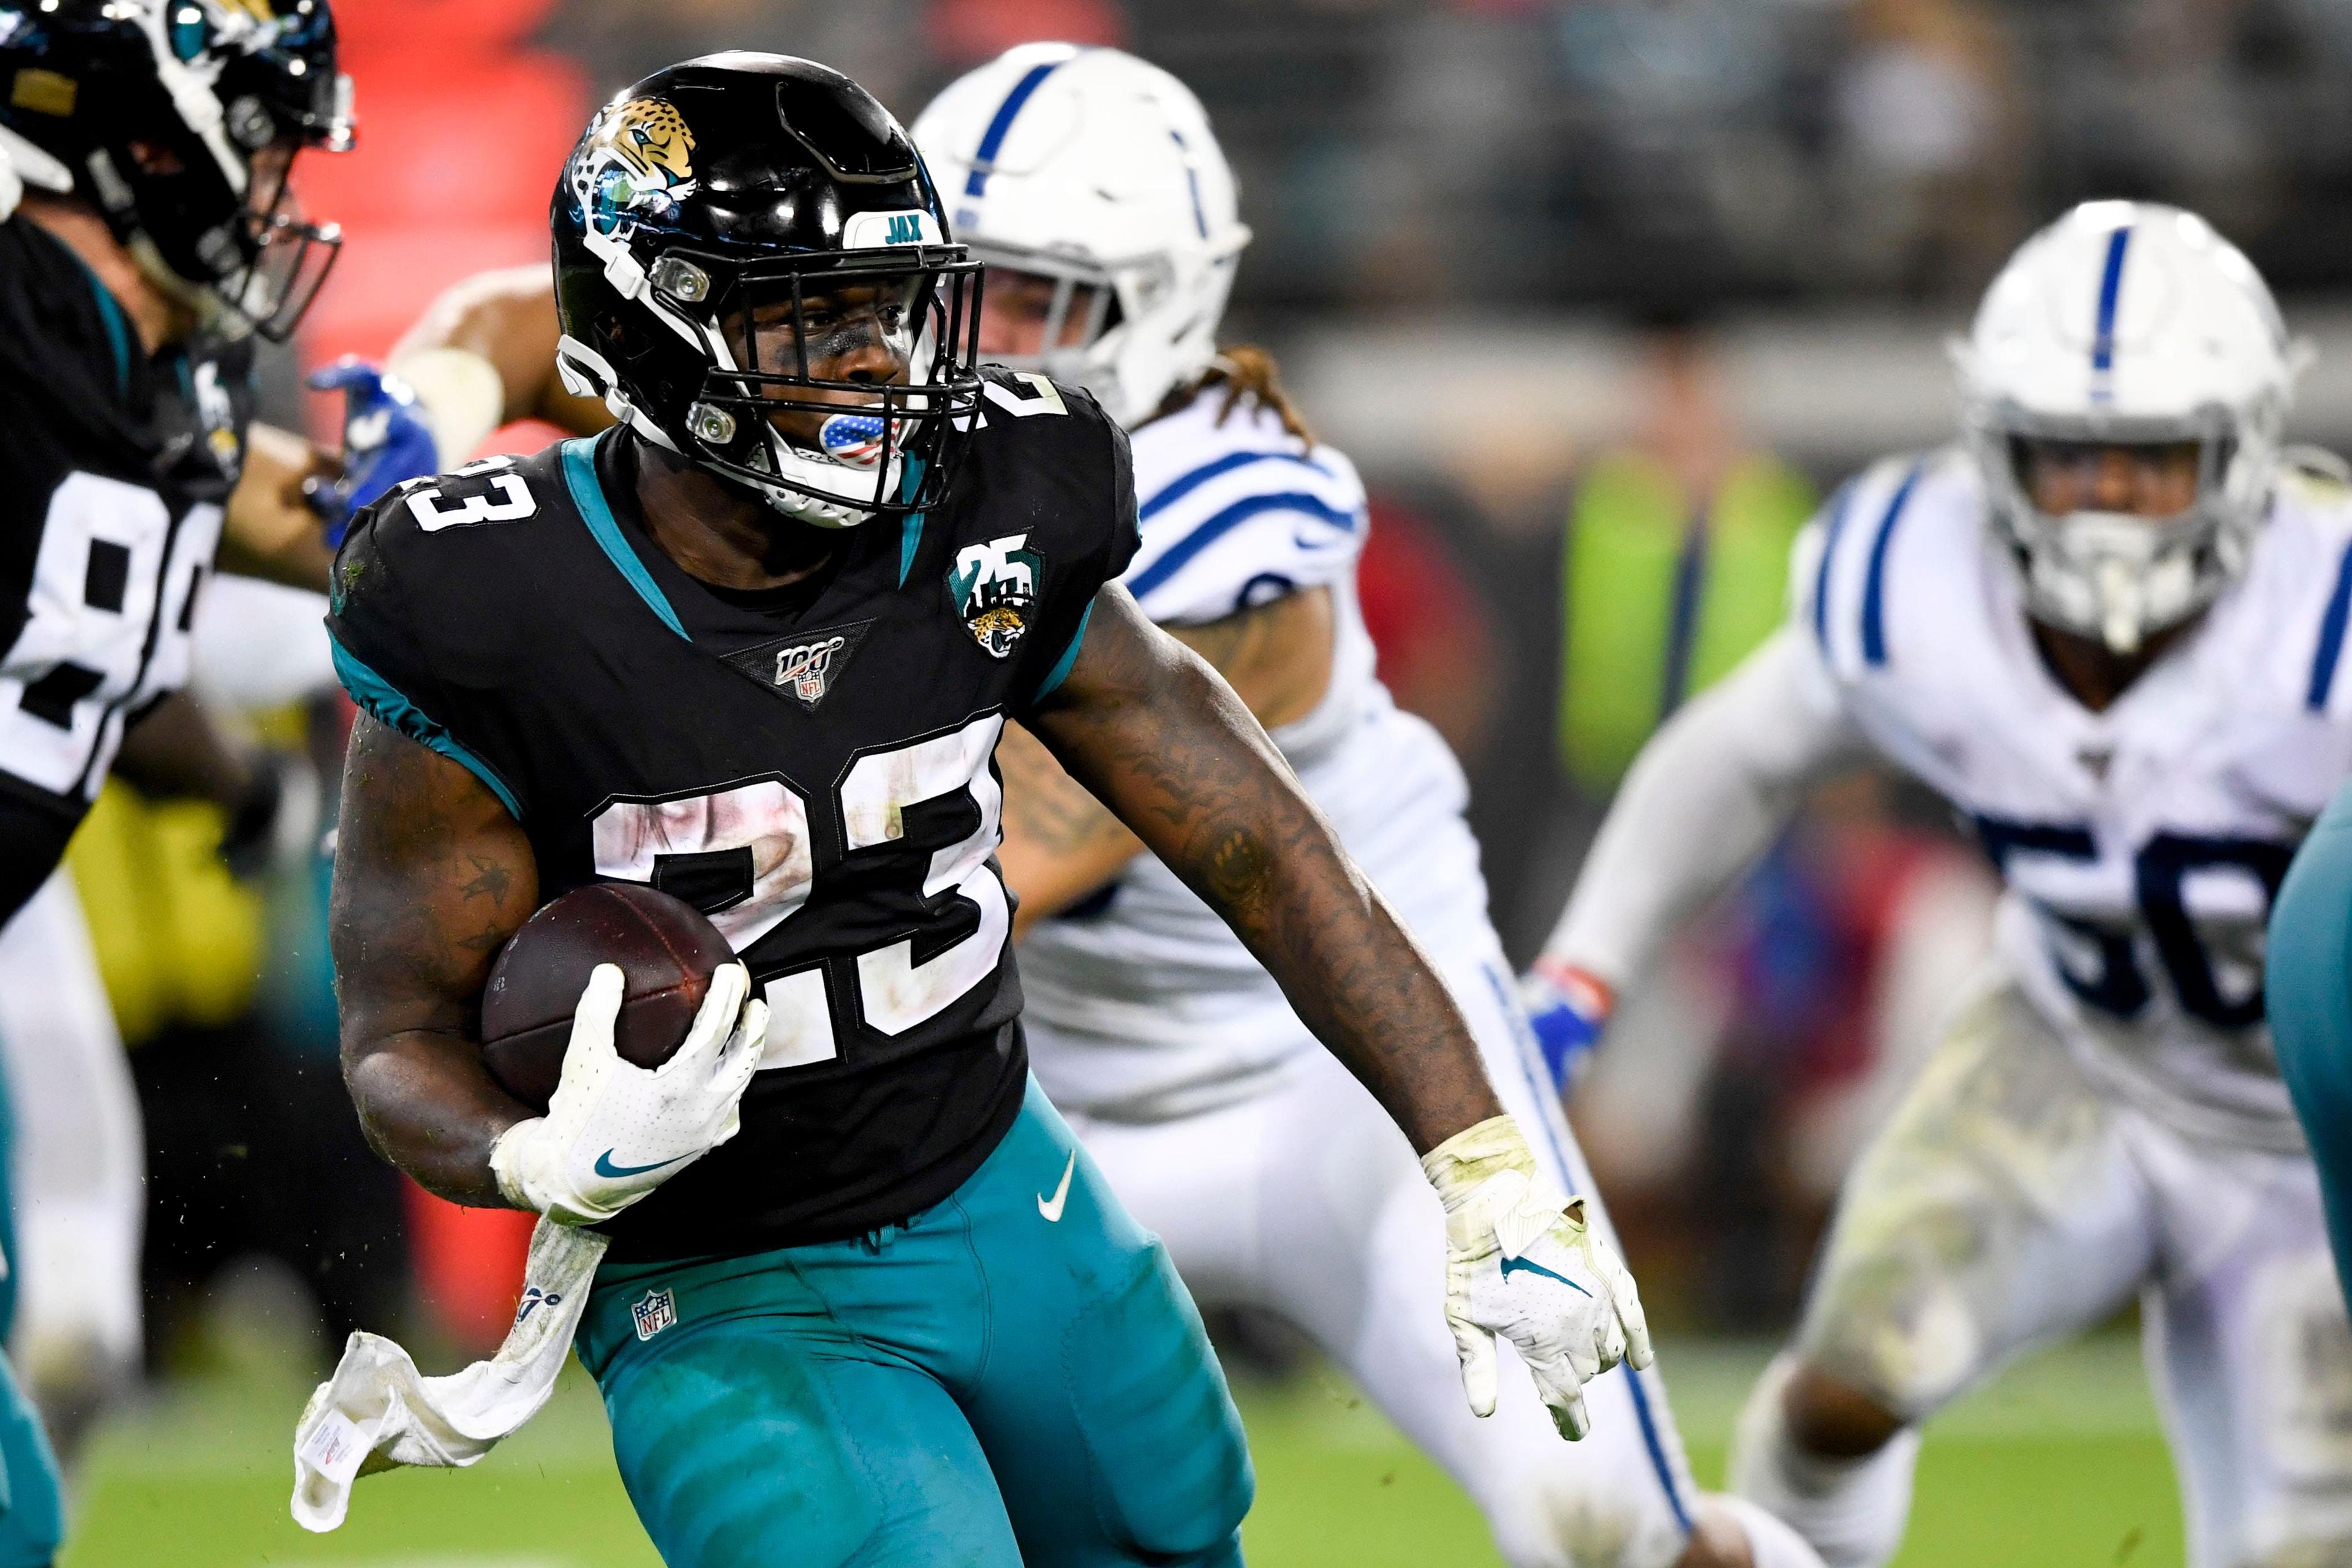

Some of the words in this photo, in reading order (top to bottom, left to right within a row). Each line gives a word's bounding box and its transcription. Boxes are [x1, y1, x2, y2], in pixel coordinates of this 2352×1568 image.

[885, 214, 923, 244] JAX
[956, 533, 1033, 617] 25
[777, 643, 831, 681] 100
[801, 681, 820, 695] NFL
[593, 713, 1009, 1071] 23
[1975, 811, 2297, 1027] 50
[642, 1308, 669, 1334] NFL
